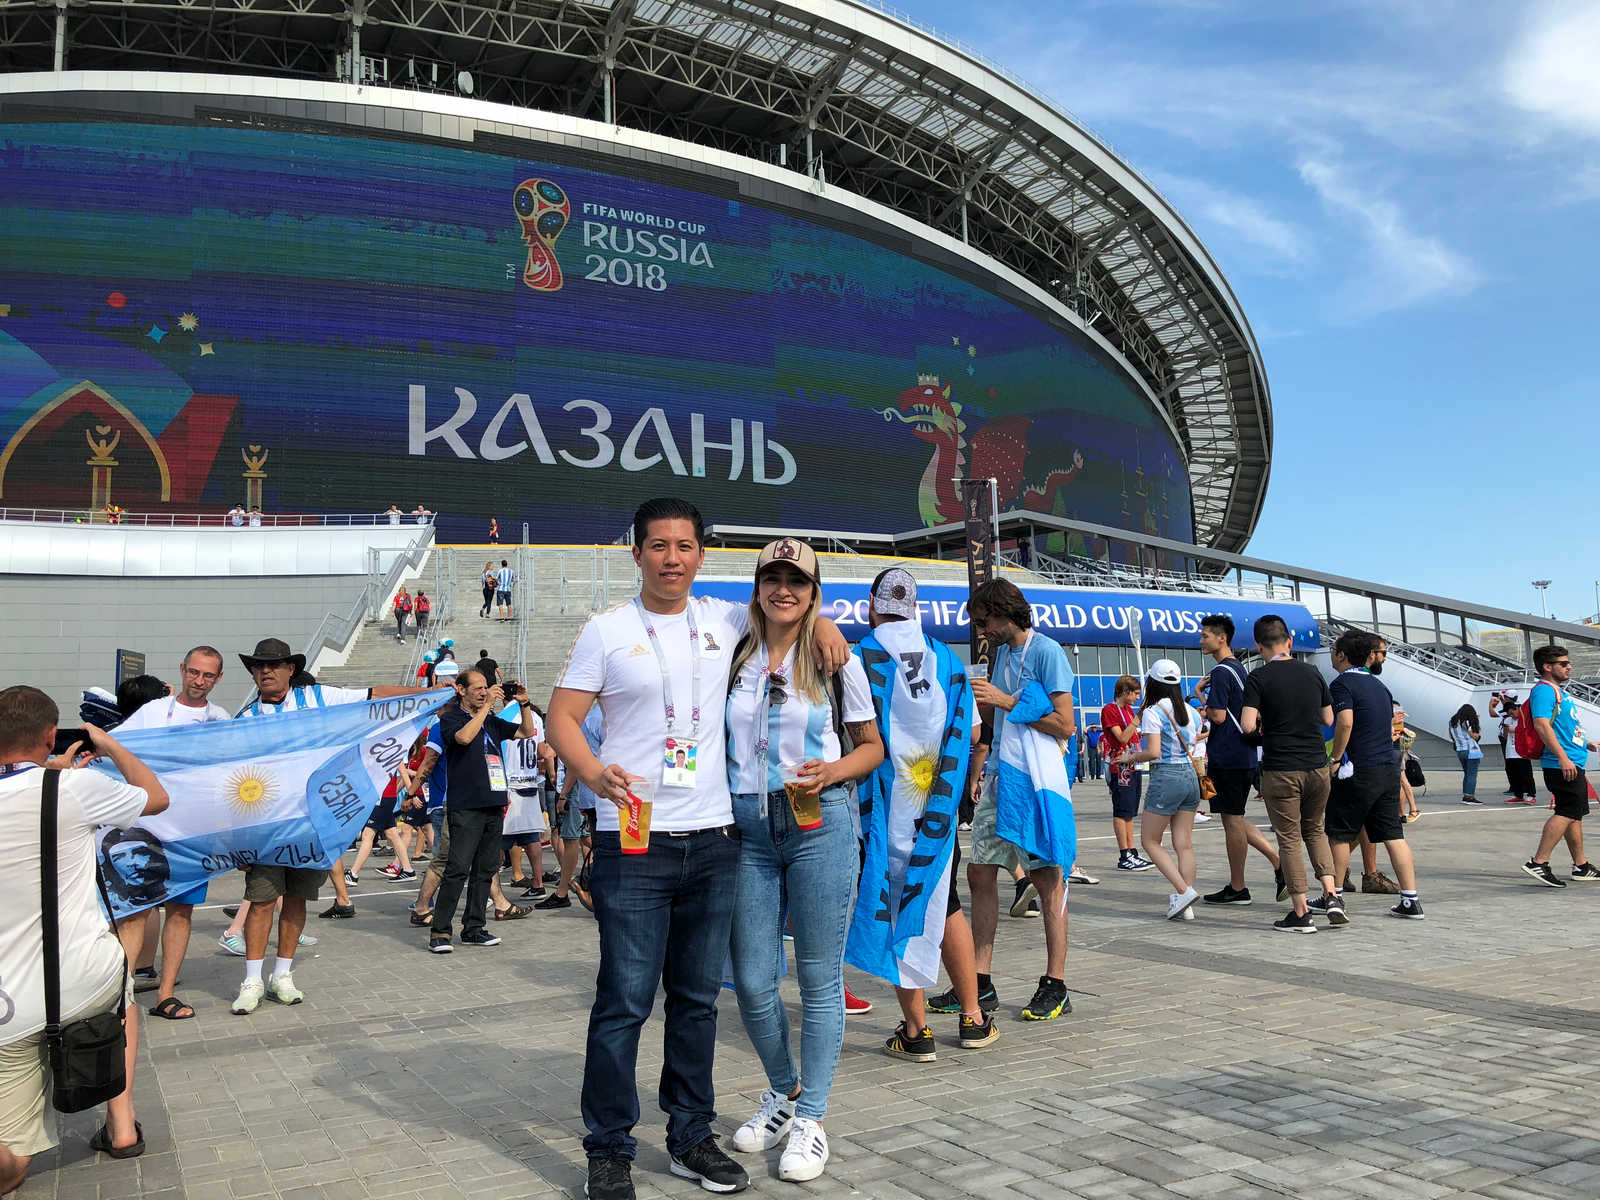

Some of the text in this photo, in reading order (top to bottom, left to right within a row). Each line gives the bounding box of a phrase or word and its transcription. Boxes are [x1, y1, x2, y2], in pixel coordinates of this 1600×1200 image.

[583, 202, 706, 236] FIFA WORLD CUP
[583, 220, 715, 269] RUSSIA
[506, 263, 516, 280] TM
[584, 254, 667, 292] 2018
[408, 383, 798, 486] КАЗАНЬ
[832, 598, 870, 625] 20
[1030, 603, 1088, 629] RLD
